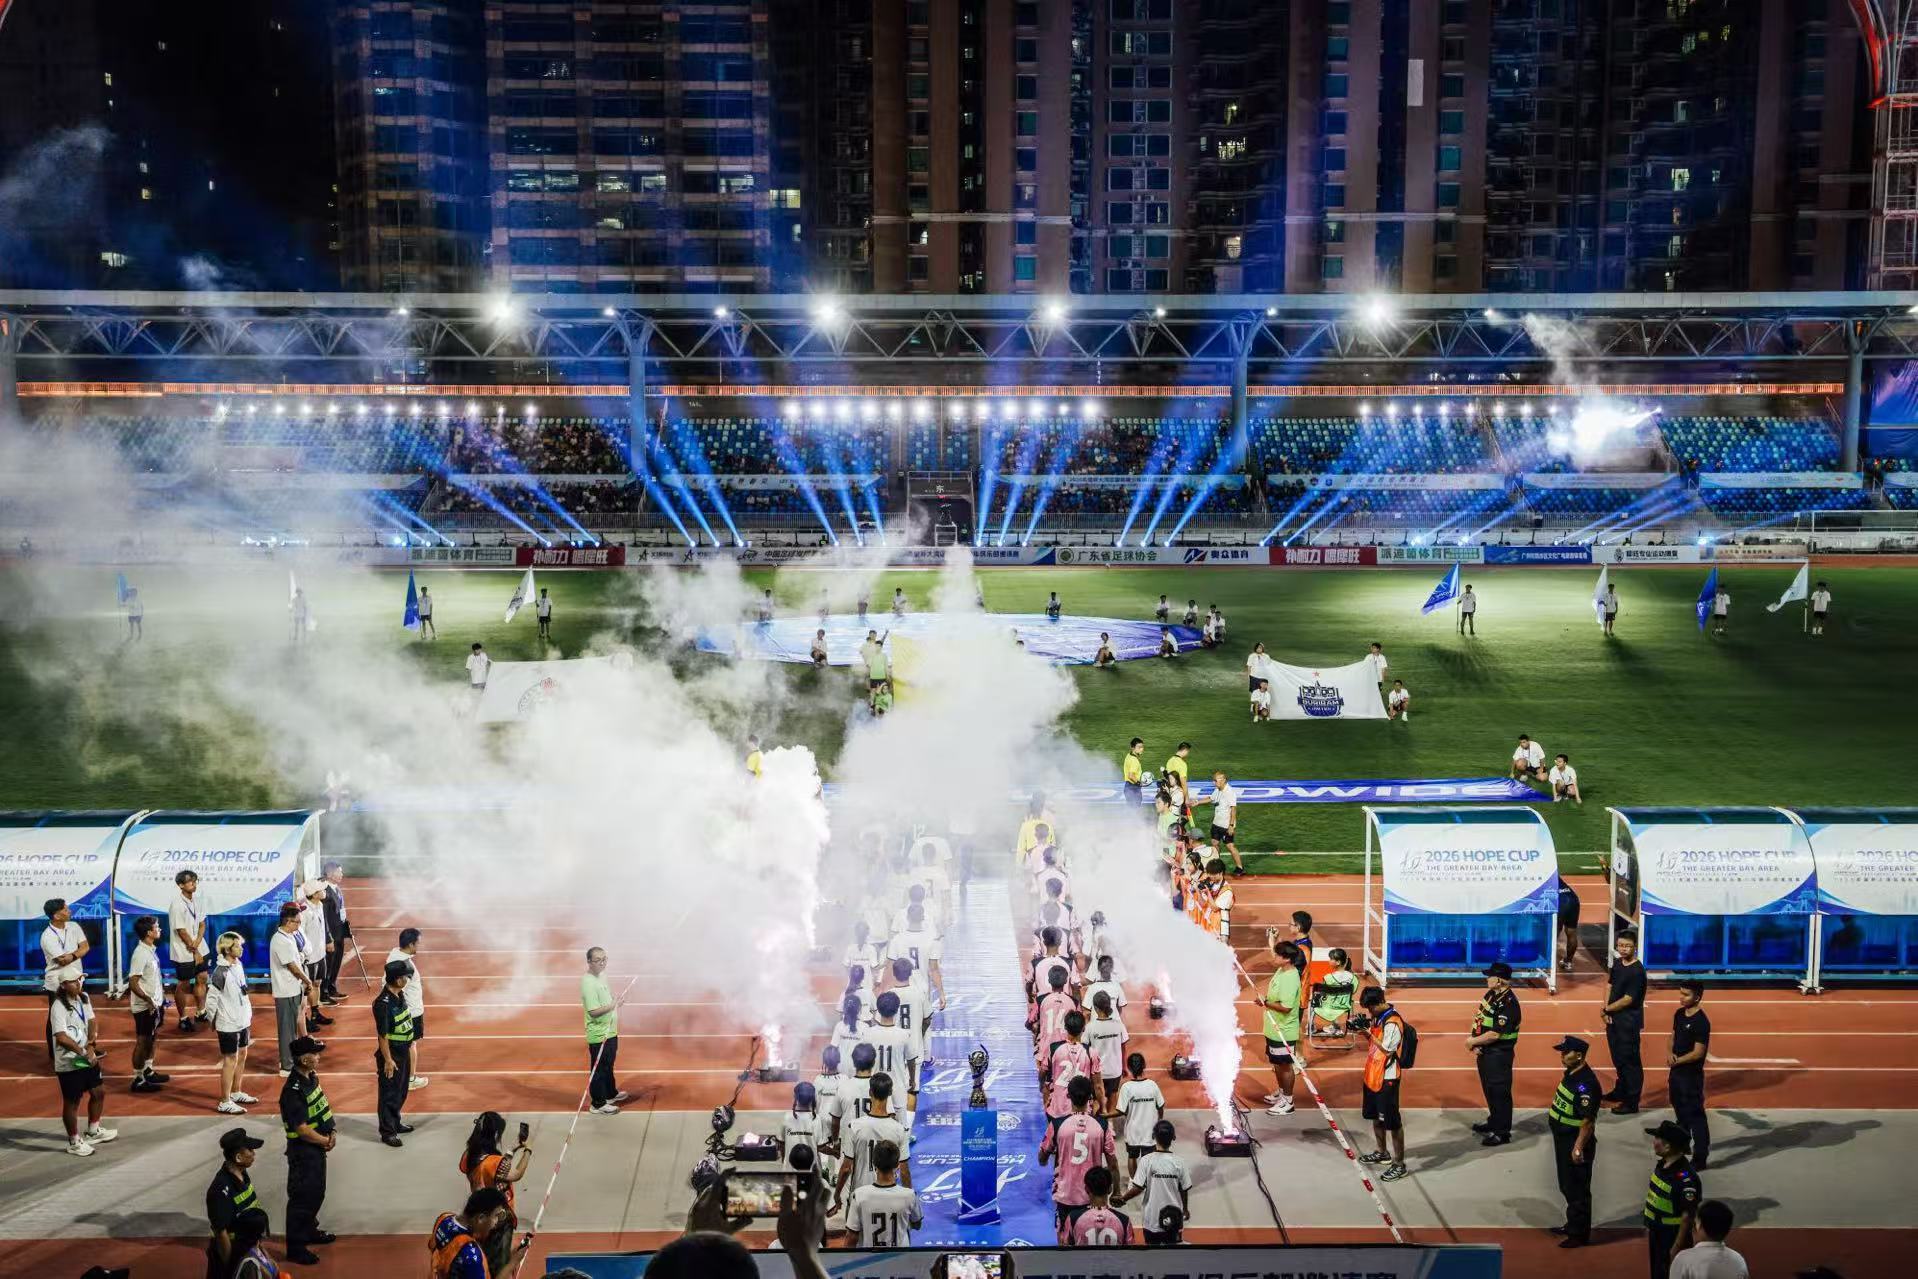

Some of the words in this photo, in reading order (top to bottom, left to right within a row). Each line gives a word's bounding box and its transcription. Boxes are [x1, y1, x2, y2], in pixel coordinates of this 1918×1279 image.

[1078, 550, 1158, 562] 广东省足球协会
[162, 850, 199, 862] 2026
[202, 851, 246, 862] HOPE
[248, 851, 281, 863] CUP
[1424, 850, 1460, 862] 2026
[1463, 850, 1505, 862] HOPE
[1508, 850, 1540, 862] CUP
[1680, 851, 1716, 863] 2026
[1719, 851, 1761, 863] HOPE
[1856, 851, 1895, 863] 2026
[1896, 851, 1918, 863] HO
[53, 868, 76, 876] AREA
[878, 1045, 893, 1072] 11
[1071, 1131, 1089, 1164] 5
[871, 1213, 898, 1247] 21
[1085, 1228, 1118, 1246] 10
